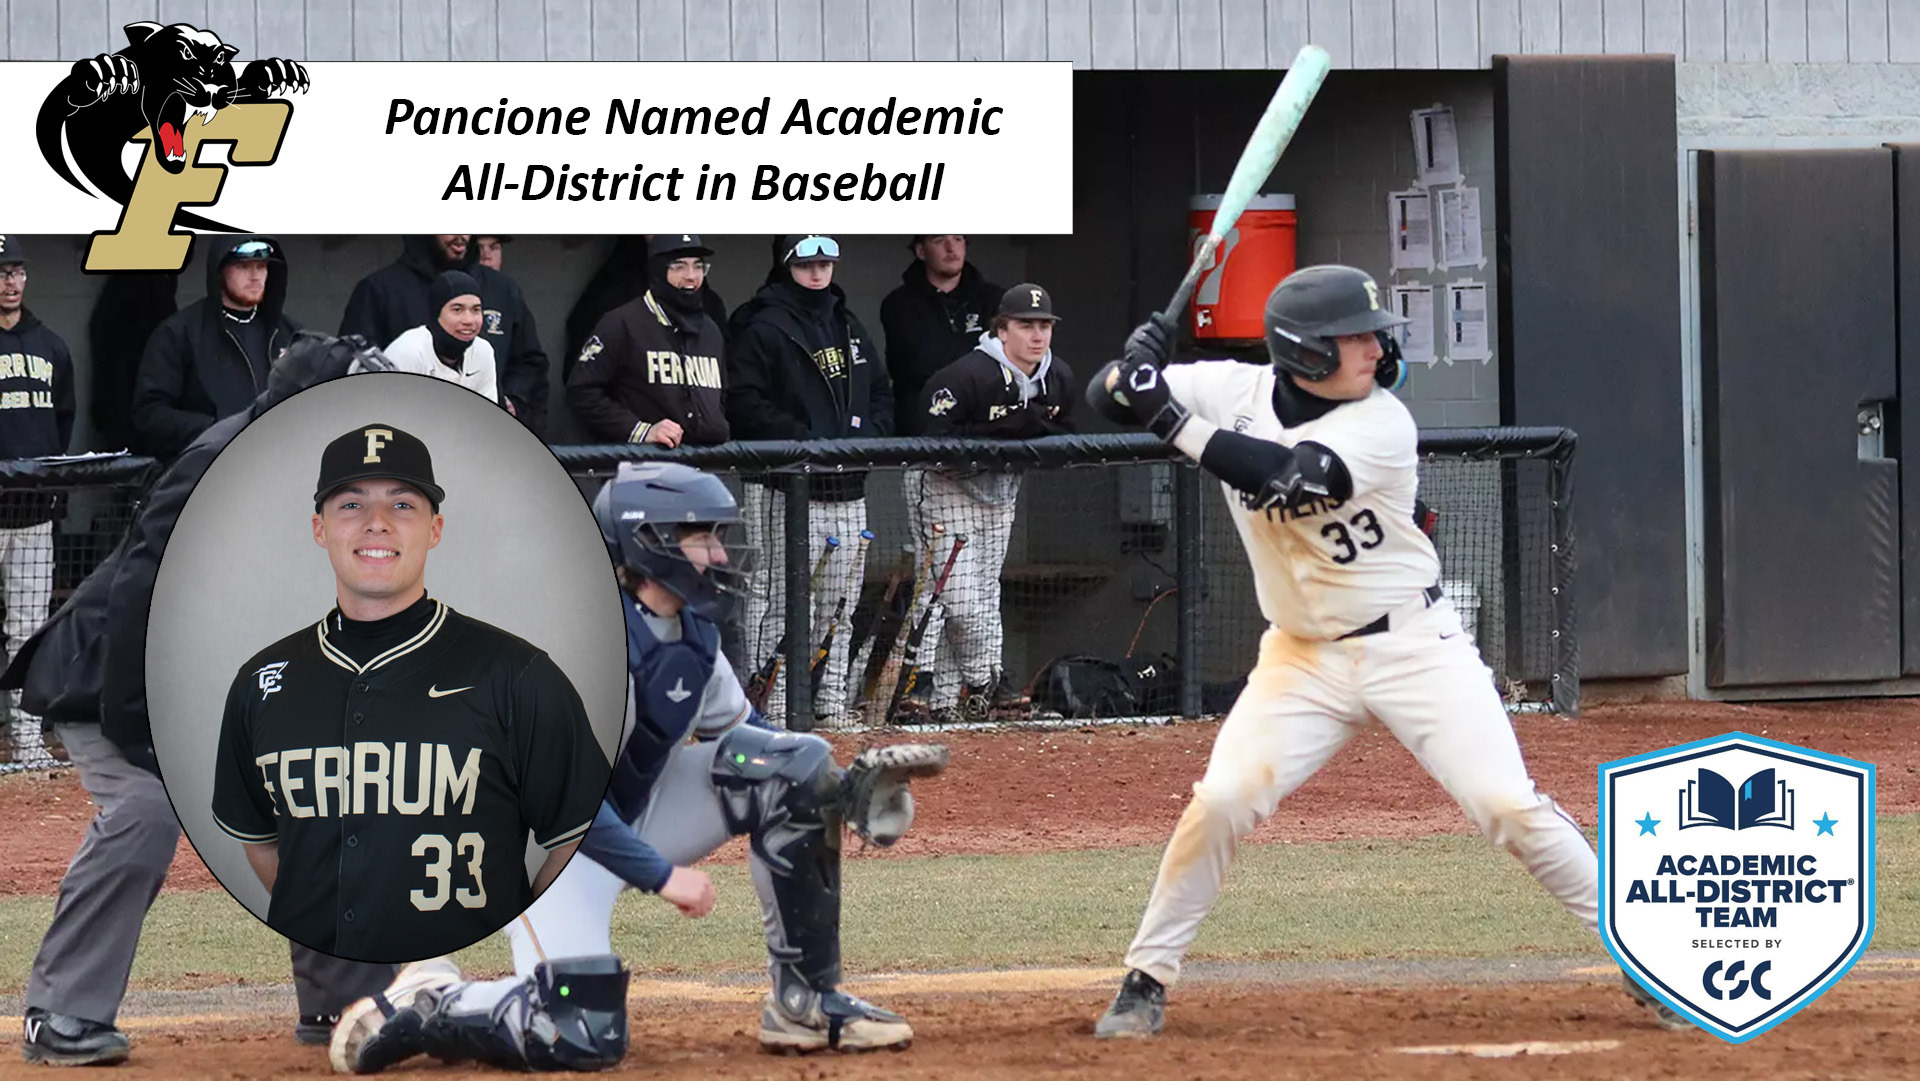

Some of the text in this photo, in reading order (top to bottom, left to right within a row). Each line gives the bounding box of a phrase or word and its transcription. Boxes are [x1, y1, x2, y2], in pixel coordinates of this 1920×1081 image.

[1030, 289, 1042, 308] F
[1363, 280, 1379, 311] F
[647, 350, 722, 388] FERRUM
[363, 428, 393, 464] F
[1321, 508, 1385, 564] 33
[256, 741, 483, 819] FERRUM
[410, 832, 487, 911] 33
